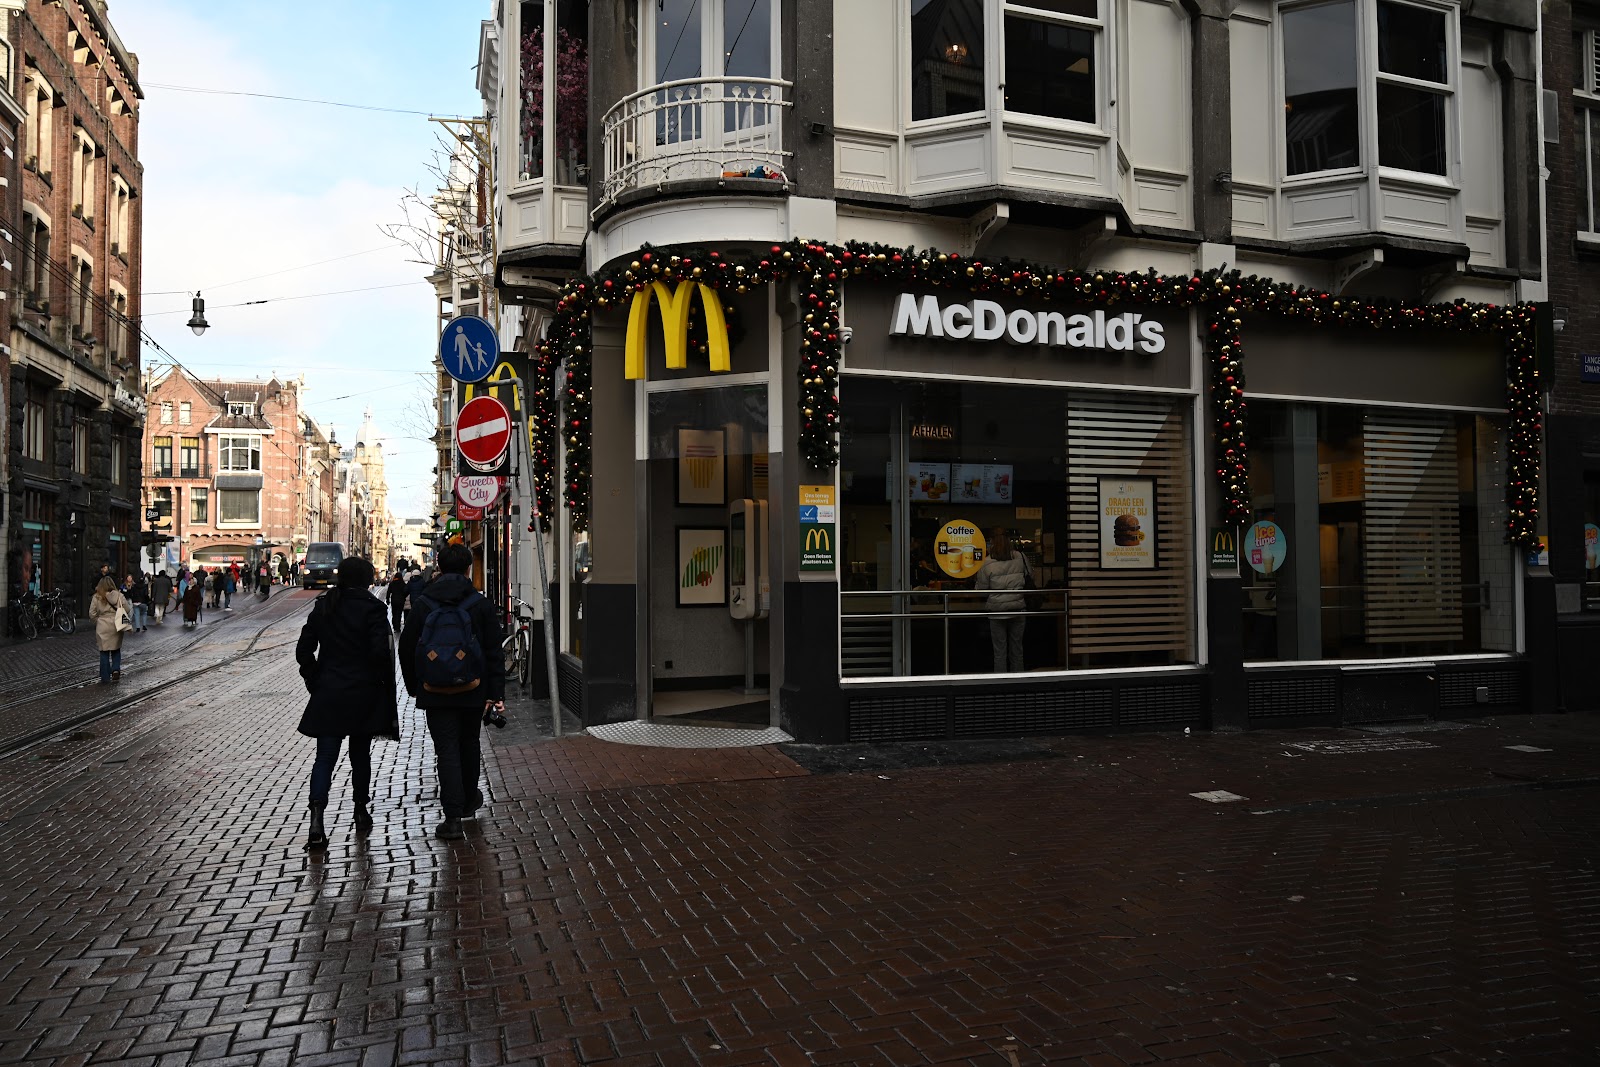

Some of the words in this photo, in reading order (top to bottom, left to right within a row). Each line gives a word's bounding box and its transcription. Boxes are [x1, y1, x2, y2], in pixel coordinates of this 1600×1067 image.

[889, 292, 1167, 354] McDonald's
[912, 426, 954, 439] AFHALEN
[461, 475, 495, 488] Sweets
[469, 487, 490, 502] City
[1108, 497, 1131, 507] DRAAG
[1132, 498, 1144, 507] EEN
[1105, 507, 1136, 516] STEENTJE
[1137, 507, 1147, 516] BIJ
[946, 526, 976, 535] Coffee
[1255, 526, 1275, 538] Ice
[1255, 537, 1275, 547] time
